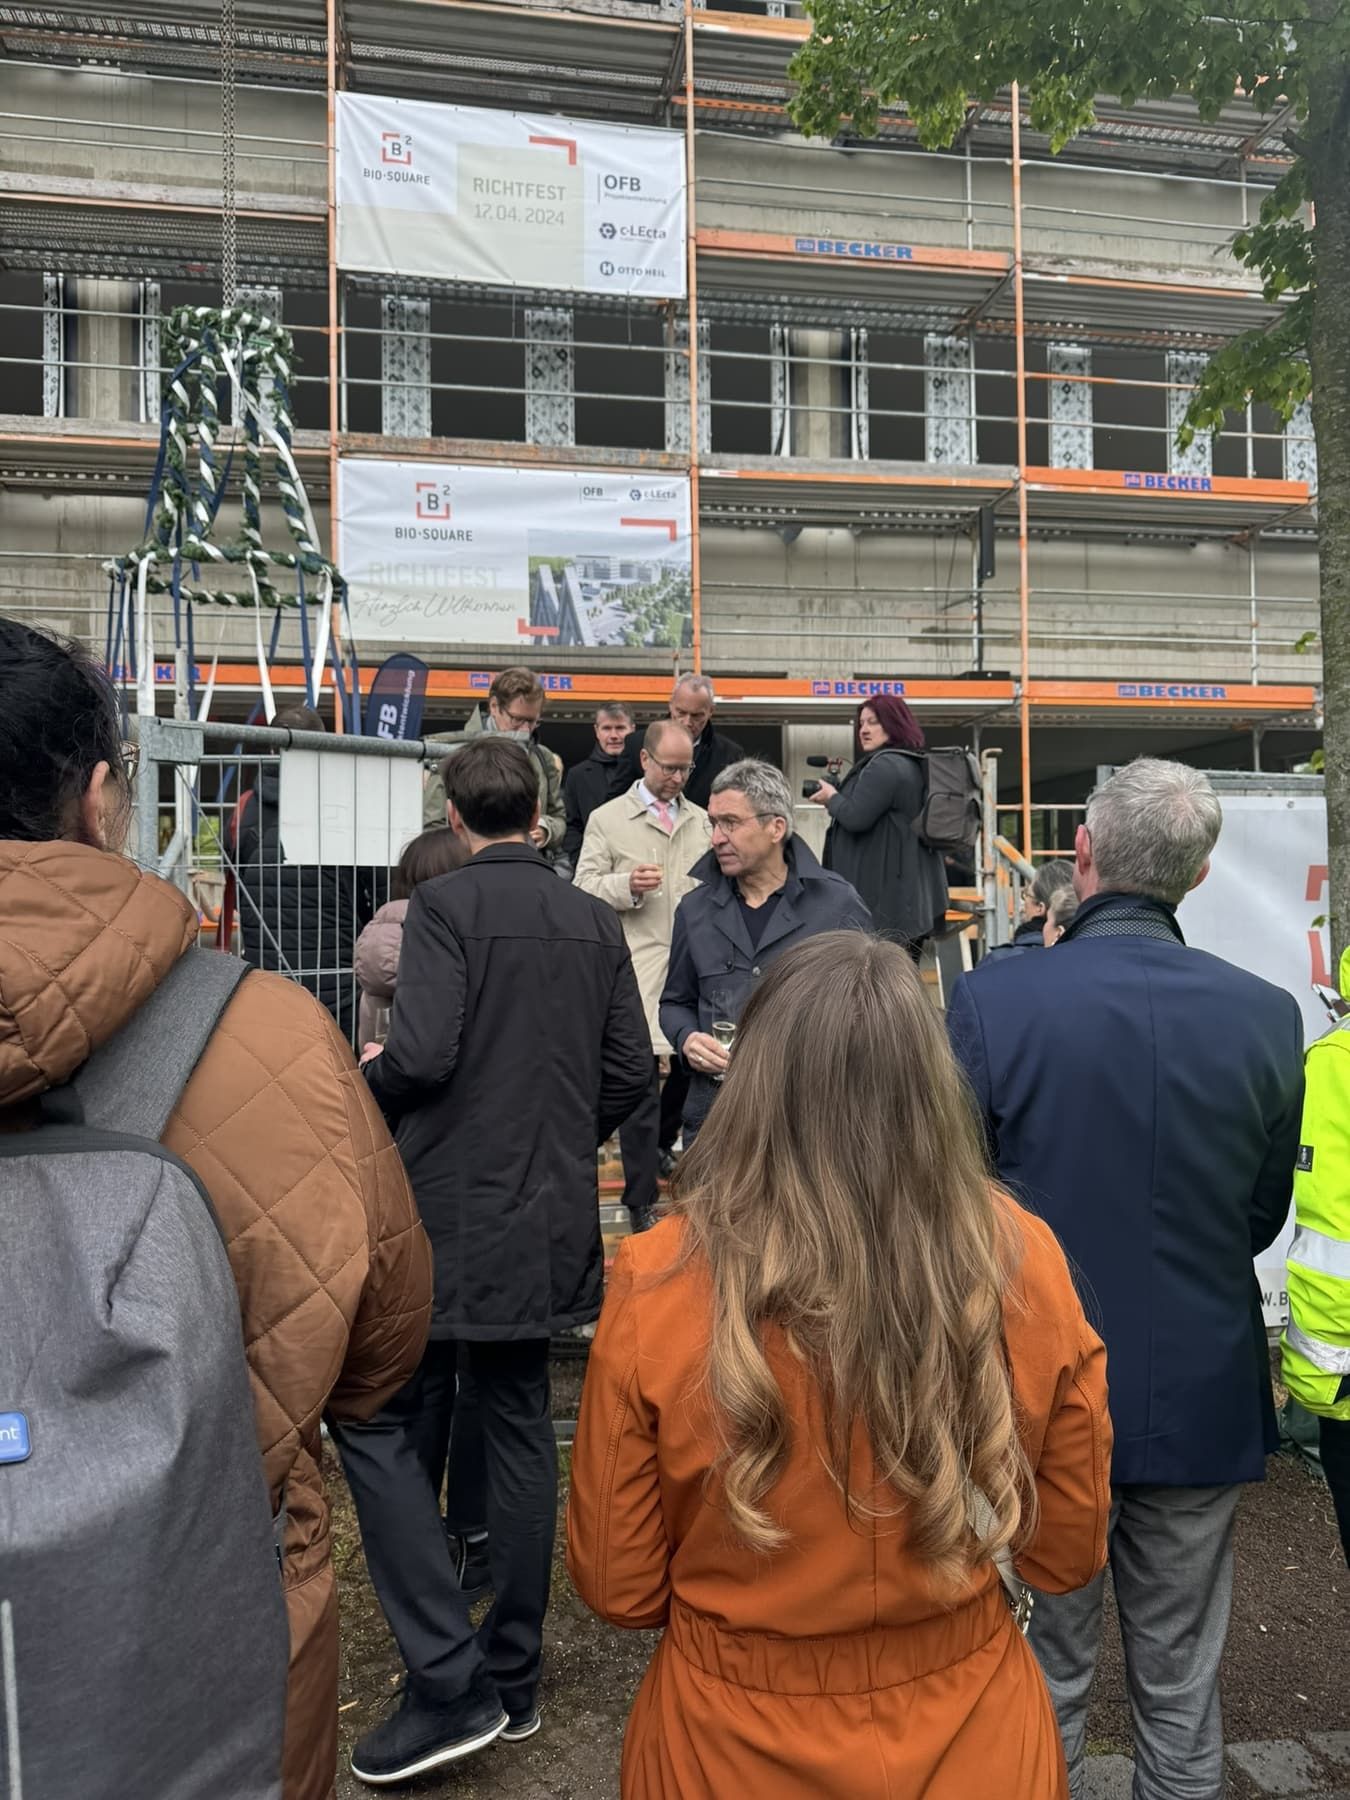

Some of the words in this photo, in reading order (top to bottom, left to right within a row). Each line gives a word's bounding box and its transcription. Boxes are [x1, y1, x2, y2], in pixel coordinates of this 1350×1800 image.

[473, 177, 567, 201] RICHTFEST
[604, 174, 641, 192] OFB
[817, 240, 913, 259] BECKER
[1144, 474, 1212, 491] BECKER
[583, 487, 603, 497] OFB
[368, 561, 502, 589] RICHTFEST
[834, 682, 905, 695] BECKER
[1138, 685, 1227, 699] BECKER
